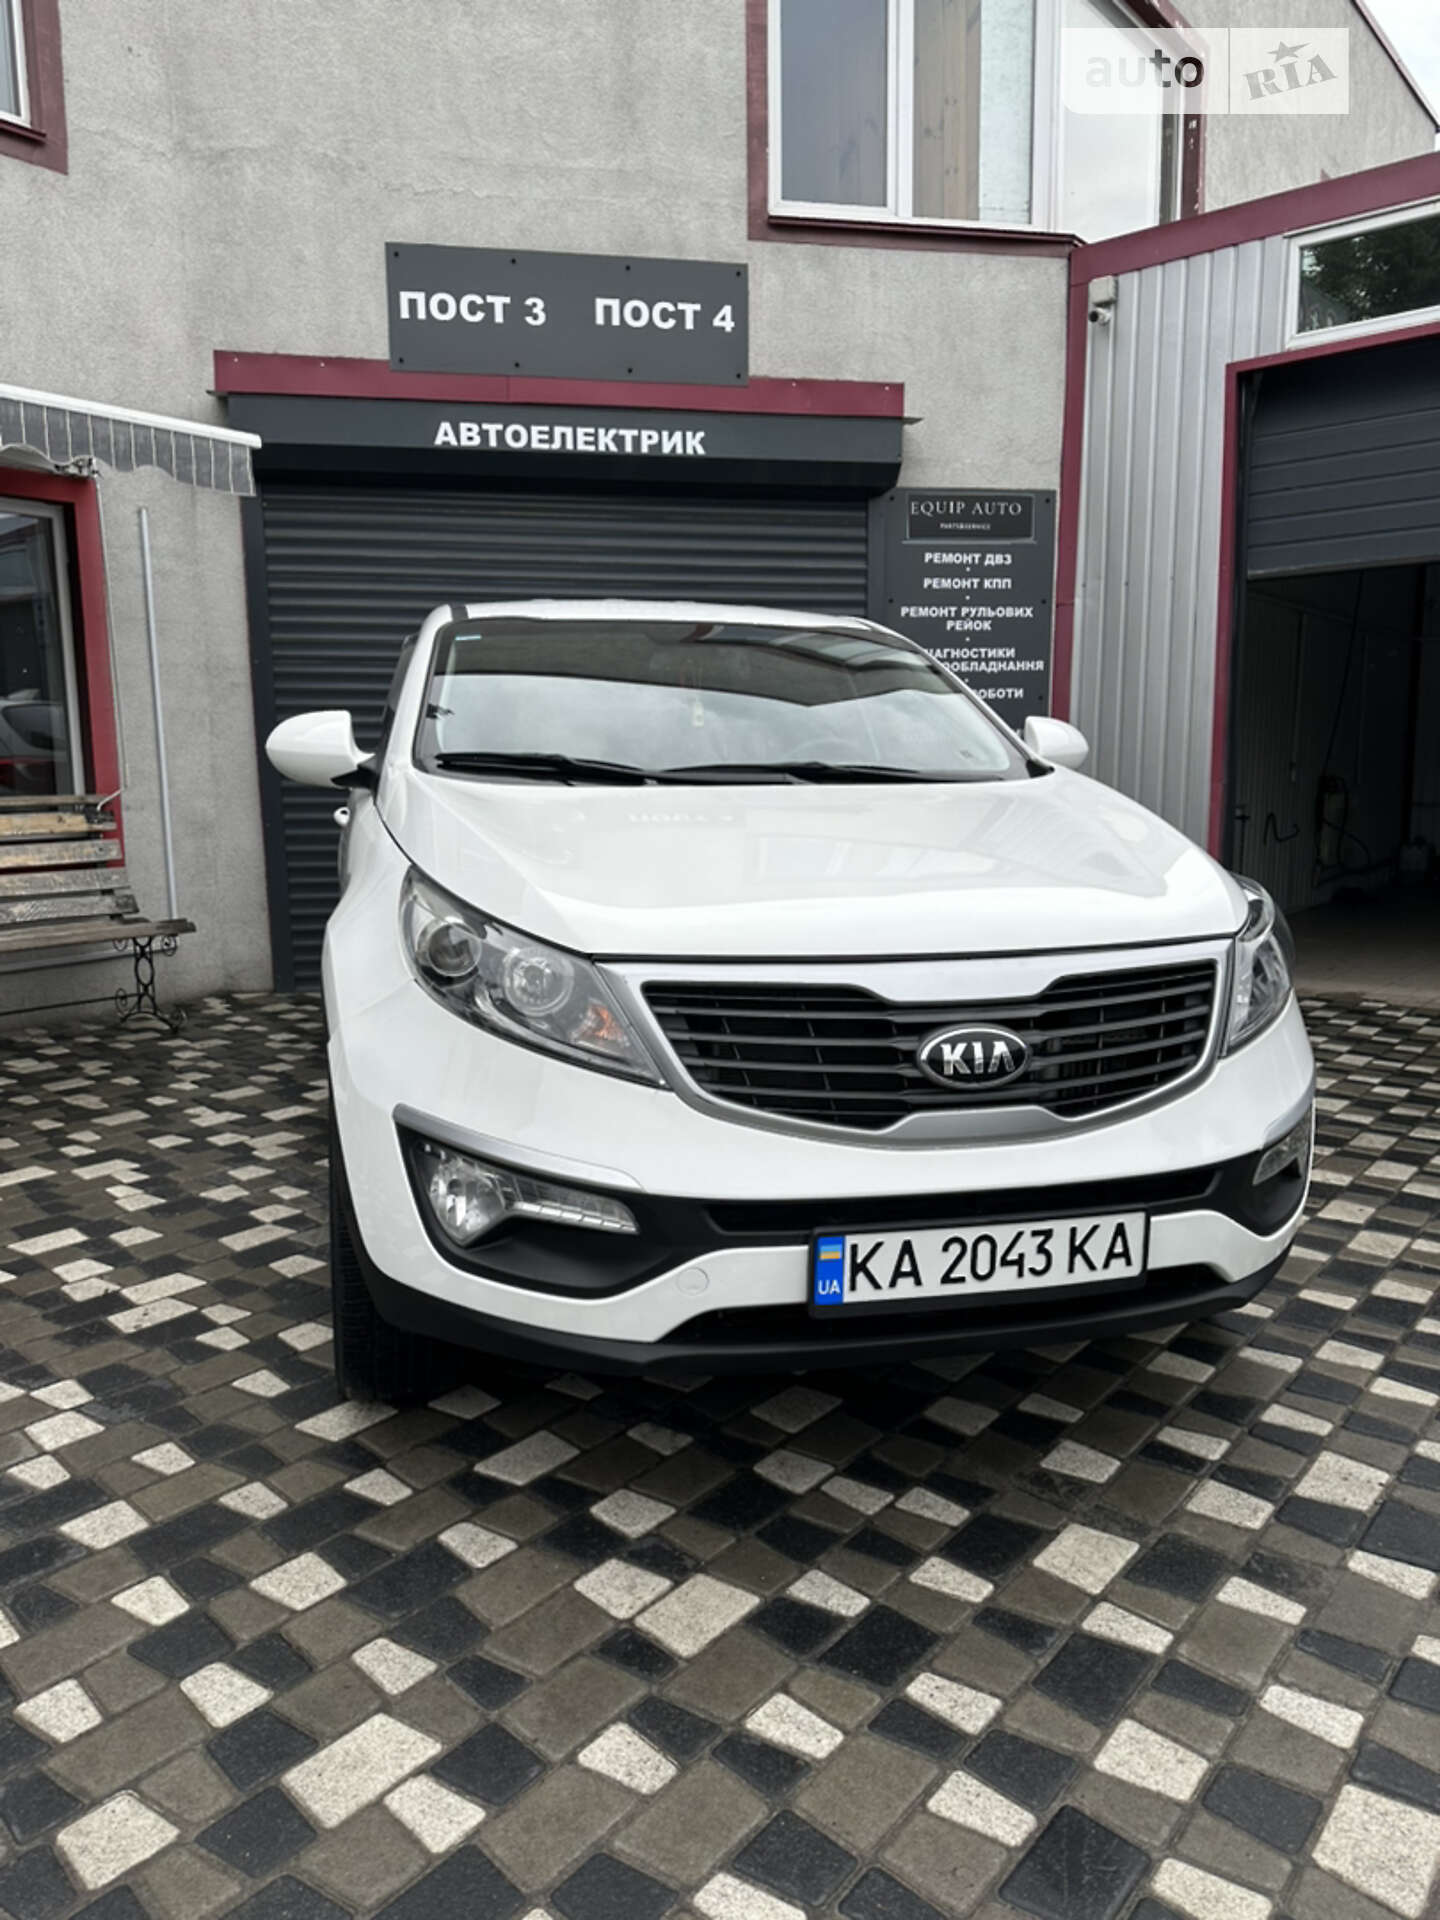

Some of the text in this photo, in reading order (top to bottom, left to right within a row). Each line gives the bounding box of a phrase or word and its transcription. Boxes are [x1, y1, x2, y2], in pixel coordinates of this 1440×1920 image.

[399, 290, 547, 327] ПОСТ 3
[595, 297, 736, 333] ПОСТ 4
[434, 420, 706, 456] АВТОЕЛЕКТРИК
[911, 500, 1023, 517] EQUIP AUTO
[924, 552, 1013, 567] РЕМОНТ ДВЗ
[923, 578, 1013, 590] РЕМОНТ КПП
[900, 606, 1034, 619] РЕМОНТ РУЛЬОВИХ
[946, 617, 992, 631] РЕЙОК
[940, 1041, 1017, 1076] KIA
[849, 1222, 1133, 1292] KA 2043 KA
[817, 1280, 841, 1295] UA
